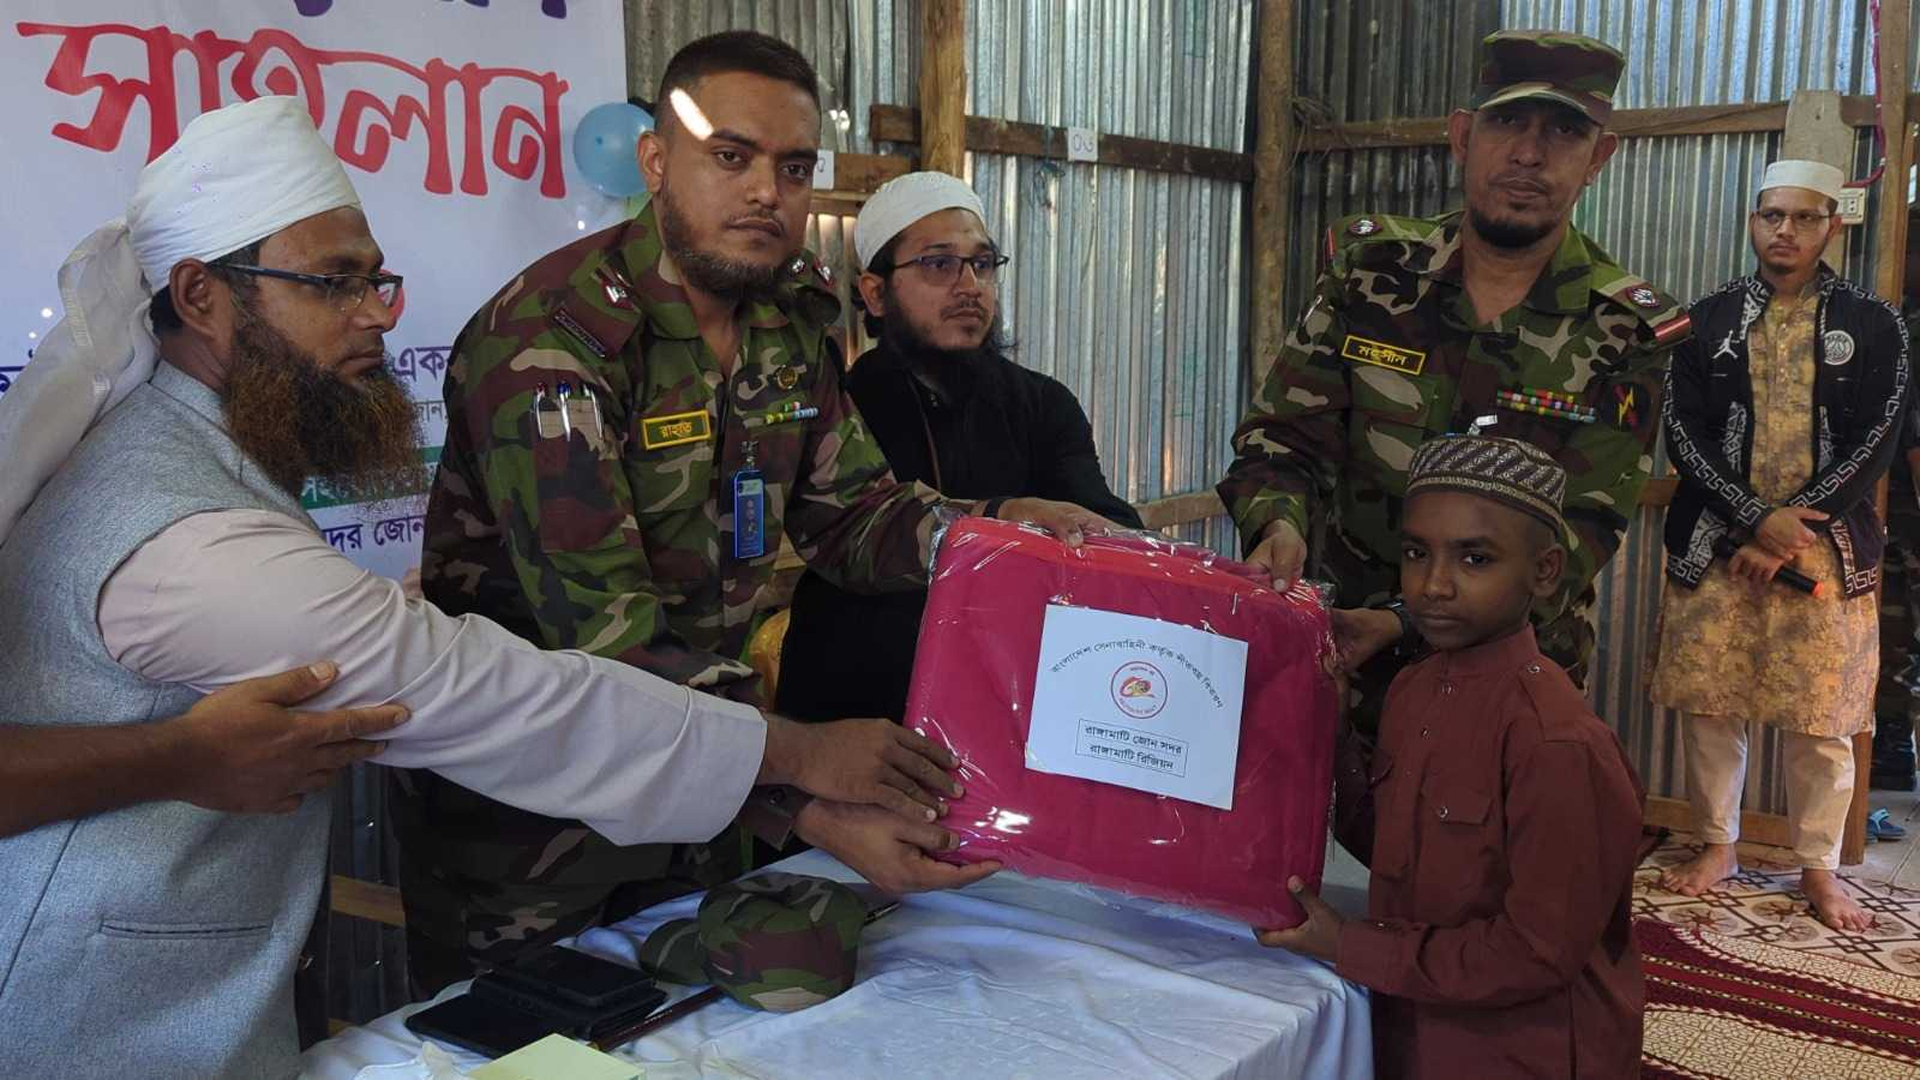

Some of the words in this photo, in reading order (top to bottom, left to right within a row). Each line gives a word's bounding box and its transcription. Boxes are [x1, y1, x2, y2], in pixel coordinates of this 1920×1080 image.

[320, 523, 363, 552] দর
[1051, 646, 1092, 673] বাংলাদেশ
[1093, 638, 1146, 652] সেনাবাহিনী
[1085, 726, 1130, 741] রাঙ্গামাটি
[1132, 735, 1158, 749] জোন
[1159, 741, 1182, 754] সদর
[1090, 744, 1135, 760] রাঙ্গামাটি
